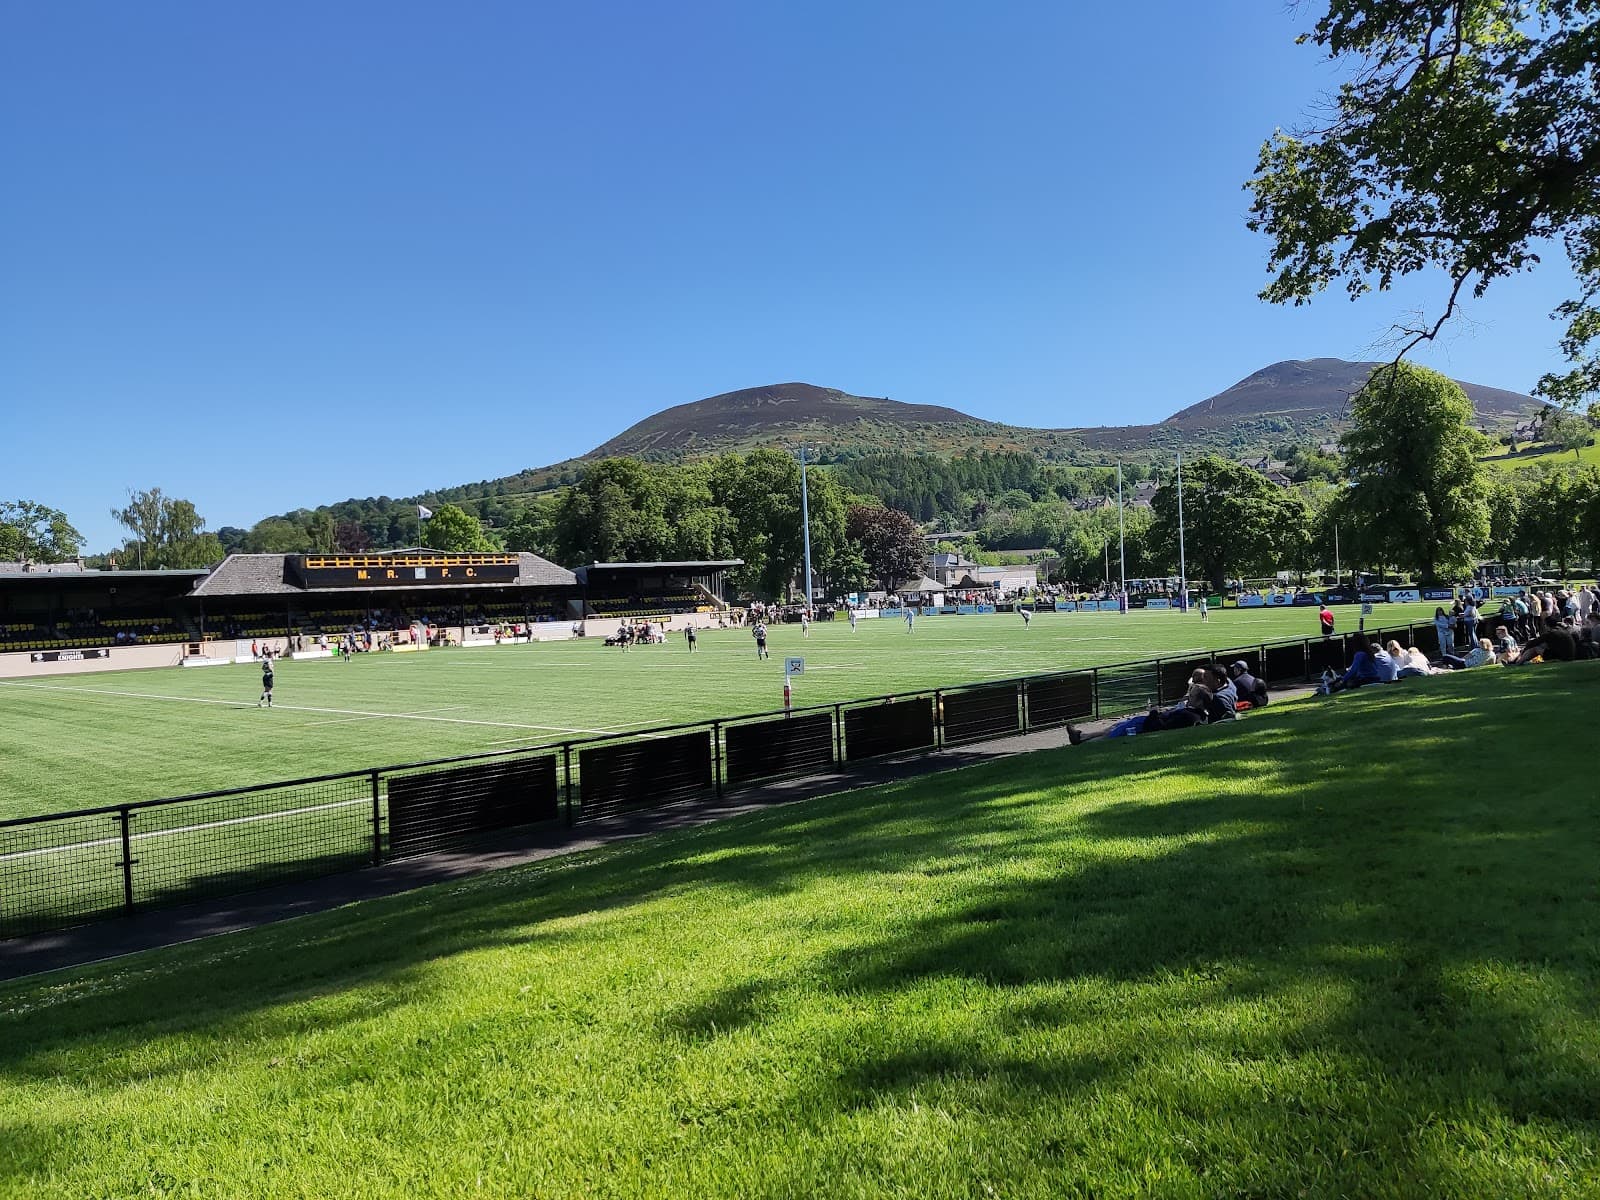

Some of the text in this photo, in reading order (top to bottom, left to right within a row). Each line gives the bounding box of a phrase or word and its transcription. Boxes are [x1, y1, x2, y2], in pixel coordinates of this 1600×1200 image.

[357, 567, 477, 580] M. R. F. C.
